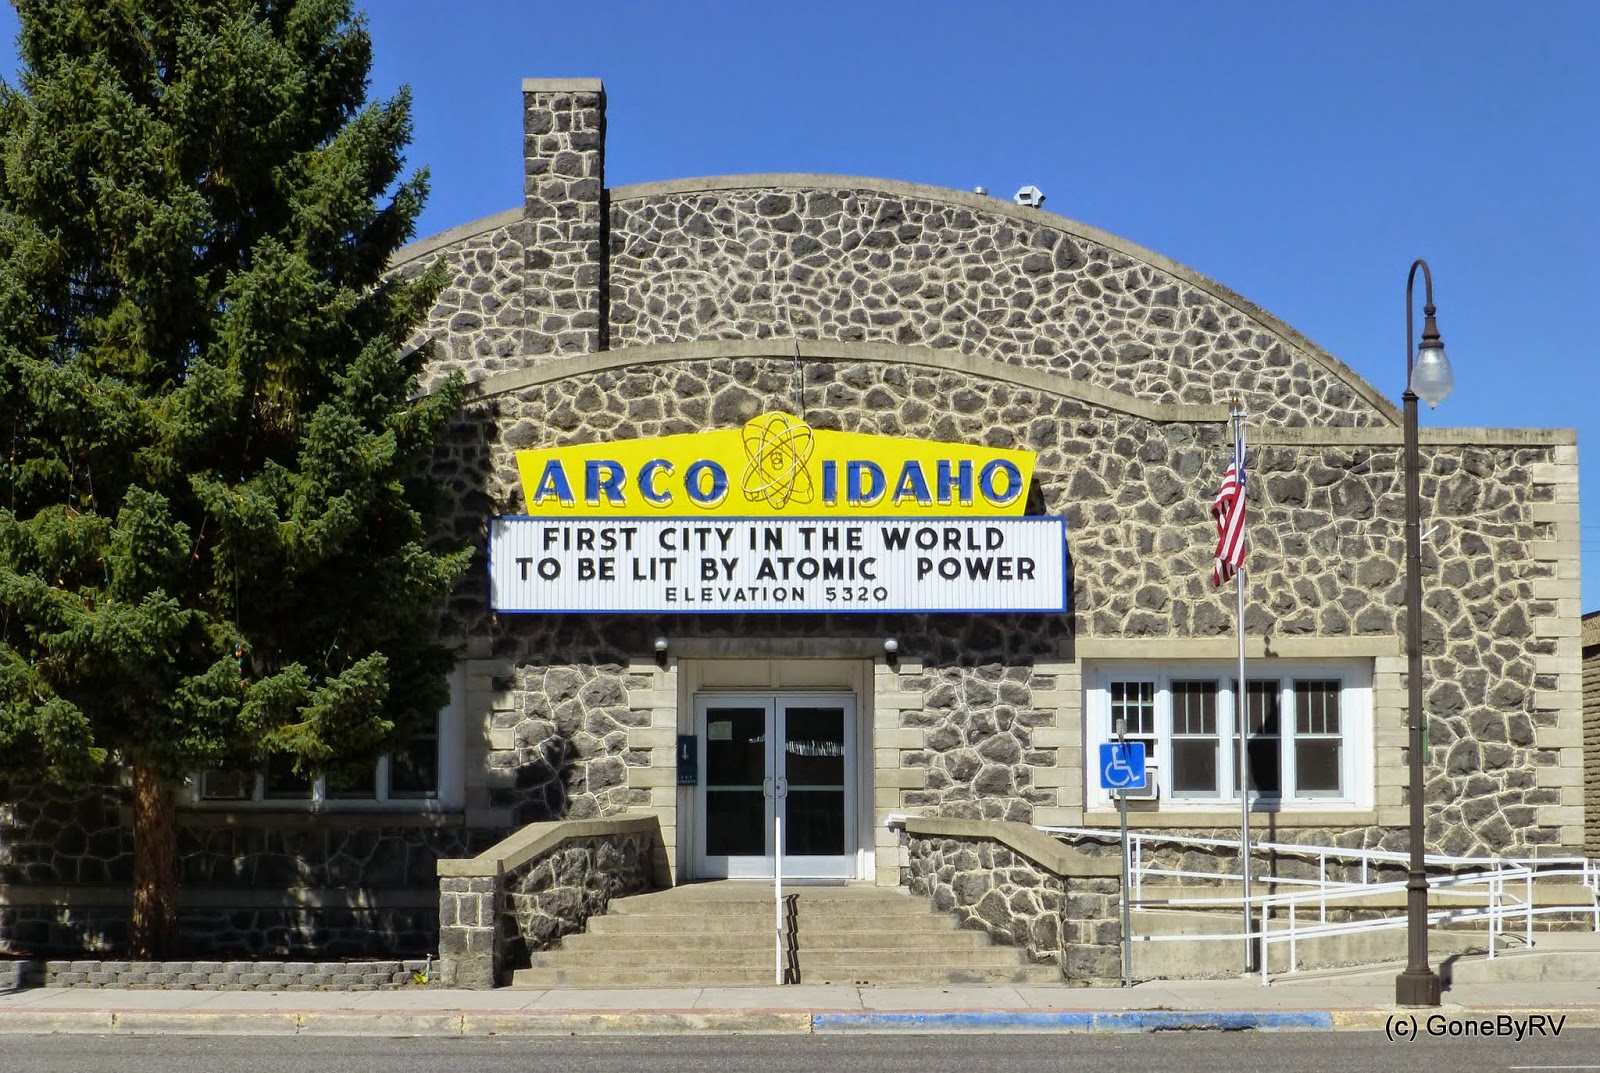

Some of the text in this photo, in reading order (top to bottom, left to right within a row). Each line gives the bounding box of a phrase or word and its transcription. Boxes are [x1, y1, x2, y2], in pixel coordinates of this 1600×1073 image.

[533, 459, 1024, 508] ARCO IDAHO
[543, 527, 1004, 552] FIRST CITY IN THE WORLD
[515, 556, 1036, 582] TO BE LIT BY ATOMIC POWER
[665, 586, 888, 603] ELEVATION 5320
